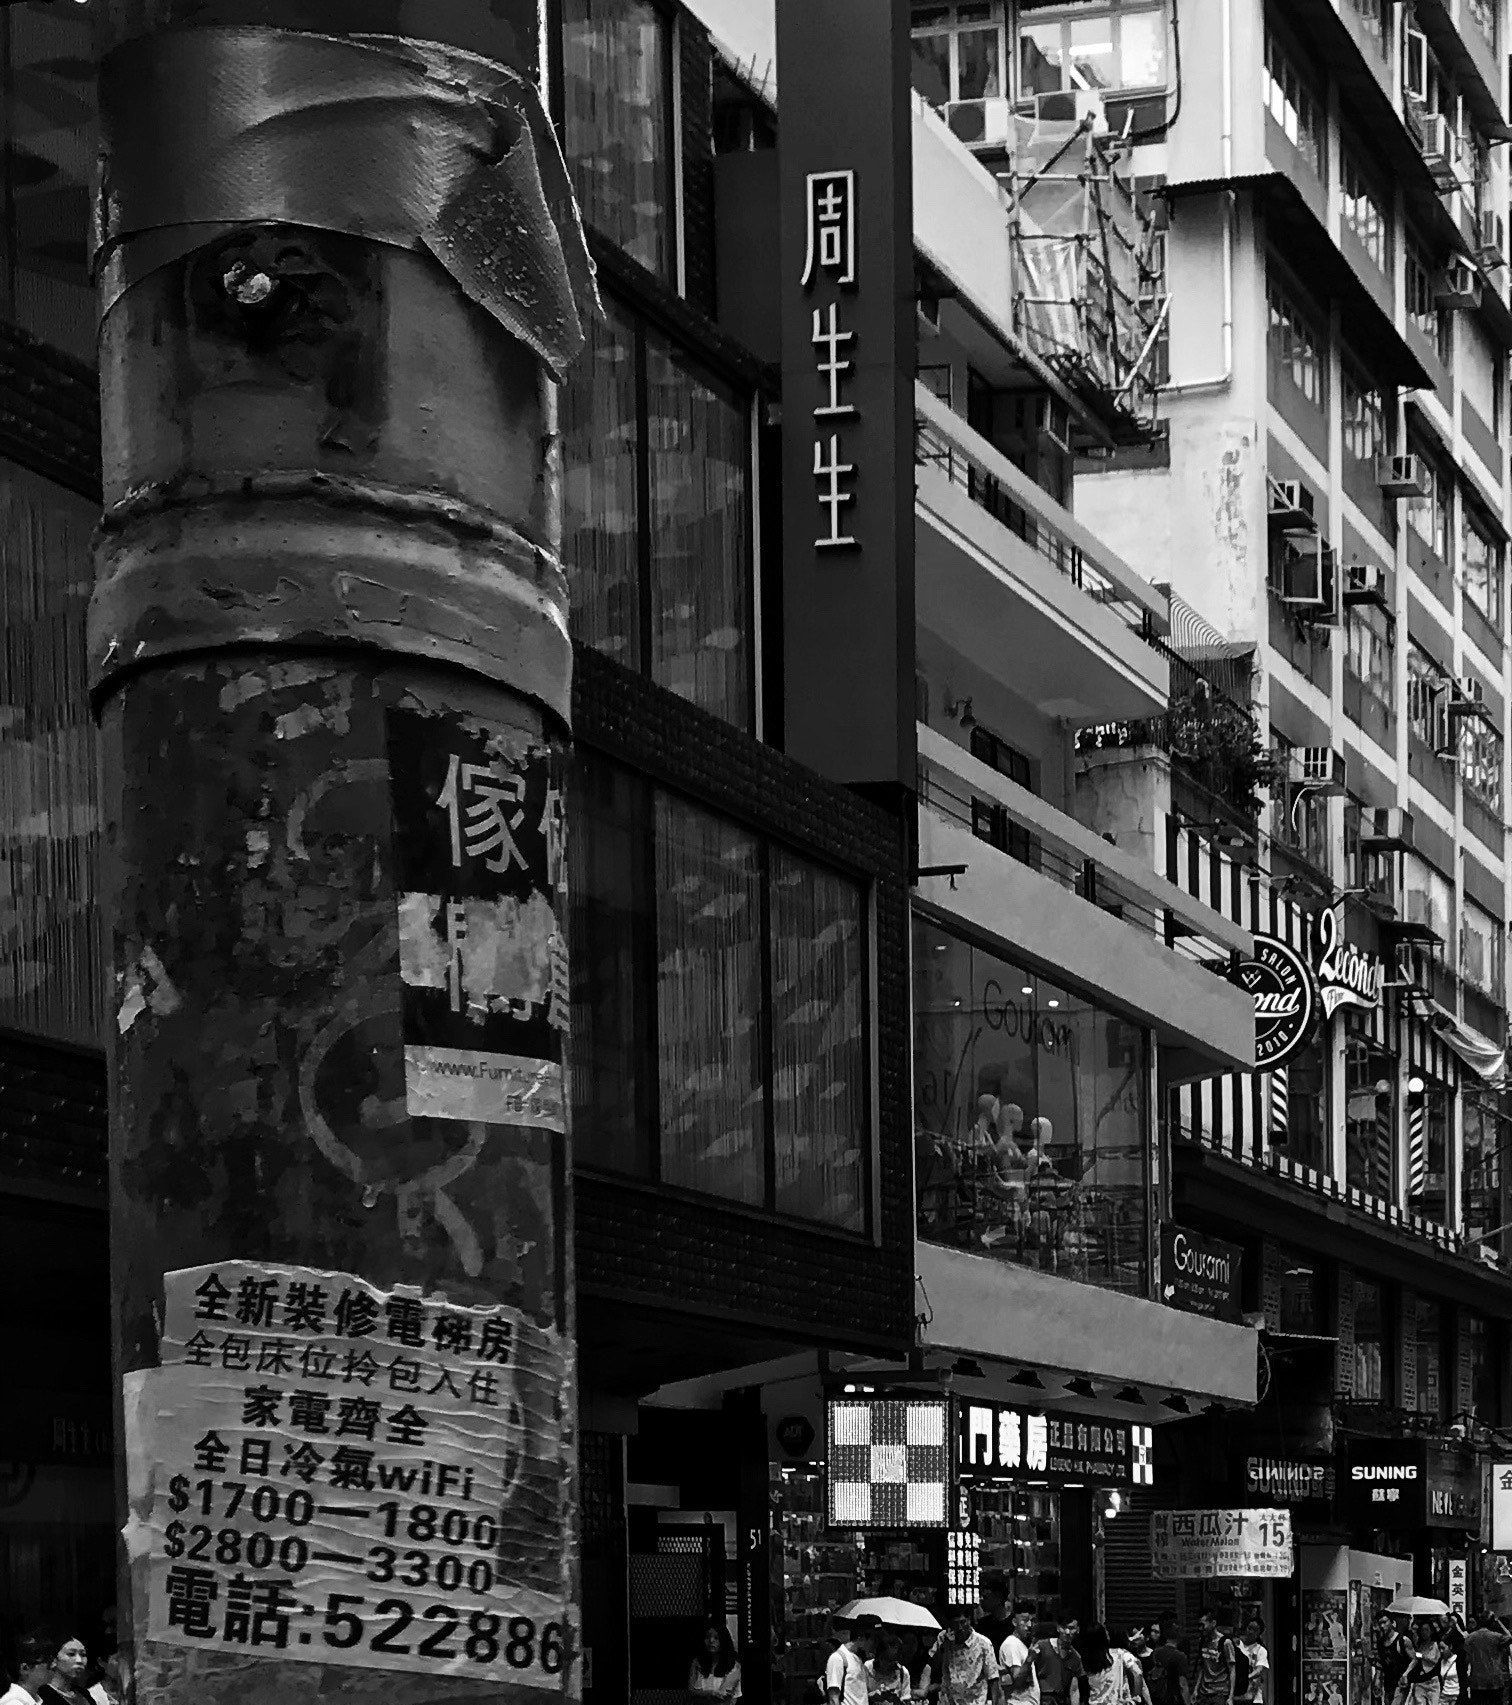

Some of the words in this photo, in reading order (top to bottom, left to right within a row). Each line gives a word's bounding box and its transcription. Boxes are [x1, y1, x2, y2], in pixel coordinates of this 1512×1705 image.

[801, 170, 856, 547] 周生生
[1260, 948, 1297, 986] SALON
[1256, 1030, 1289, 1057] 2010
[1174, 1233, 1230, 1285] Gourami
[194, 1272, 515, 1365] 全新裝修電梯房
[184, 1327, 500, 1407] 全包床位拎包入住
[242, 1383, 430, 1448] 家電齊全
[1351, 1465, 1418, 1481] SUNING
[1172, 1511, 1249, 1537] 西瓜汁
[1259, 1522, 1286, 1547] 15
